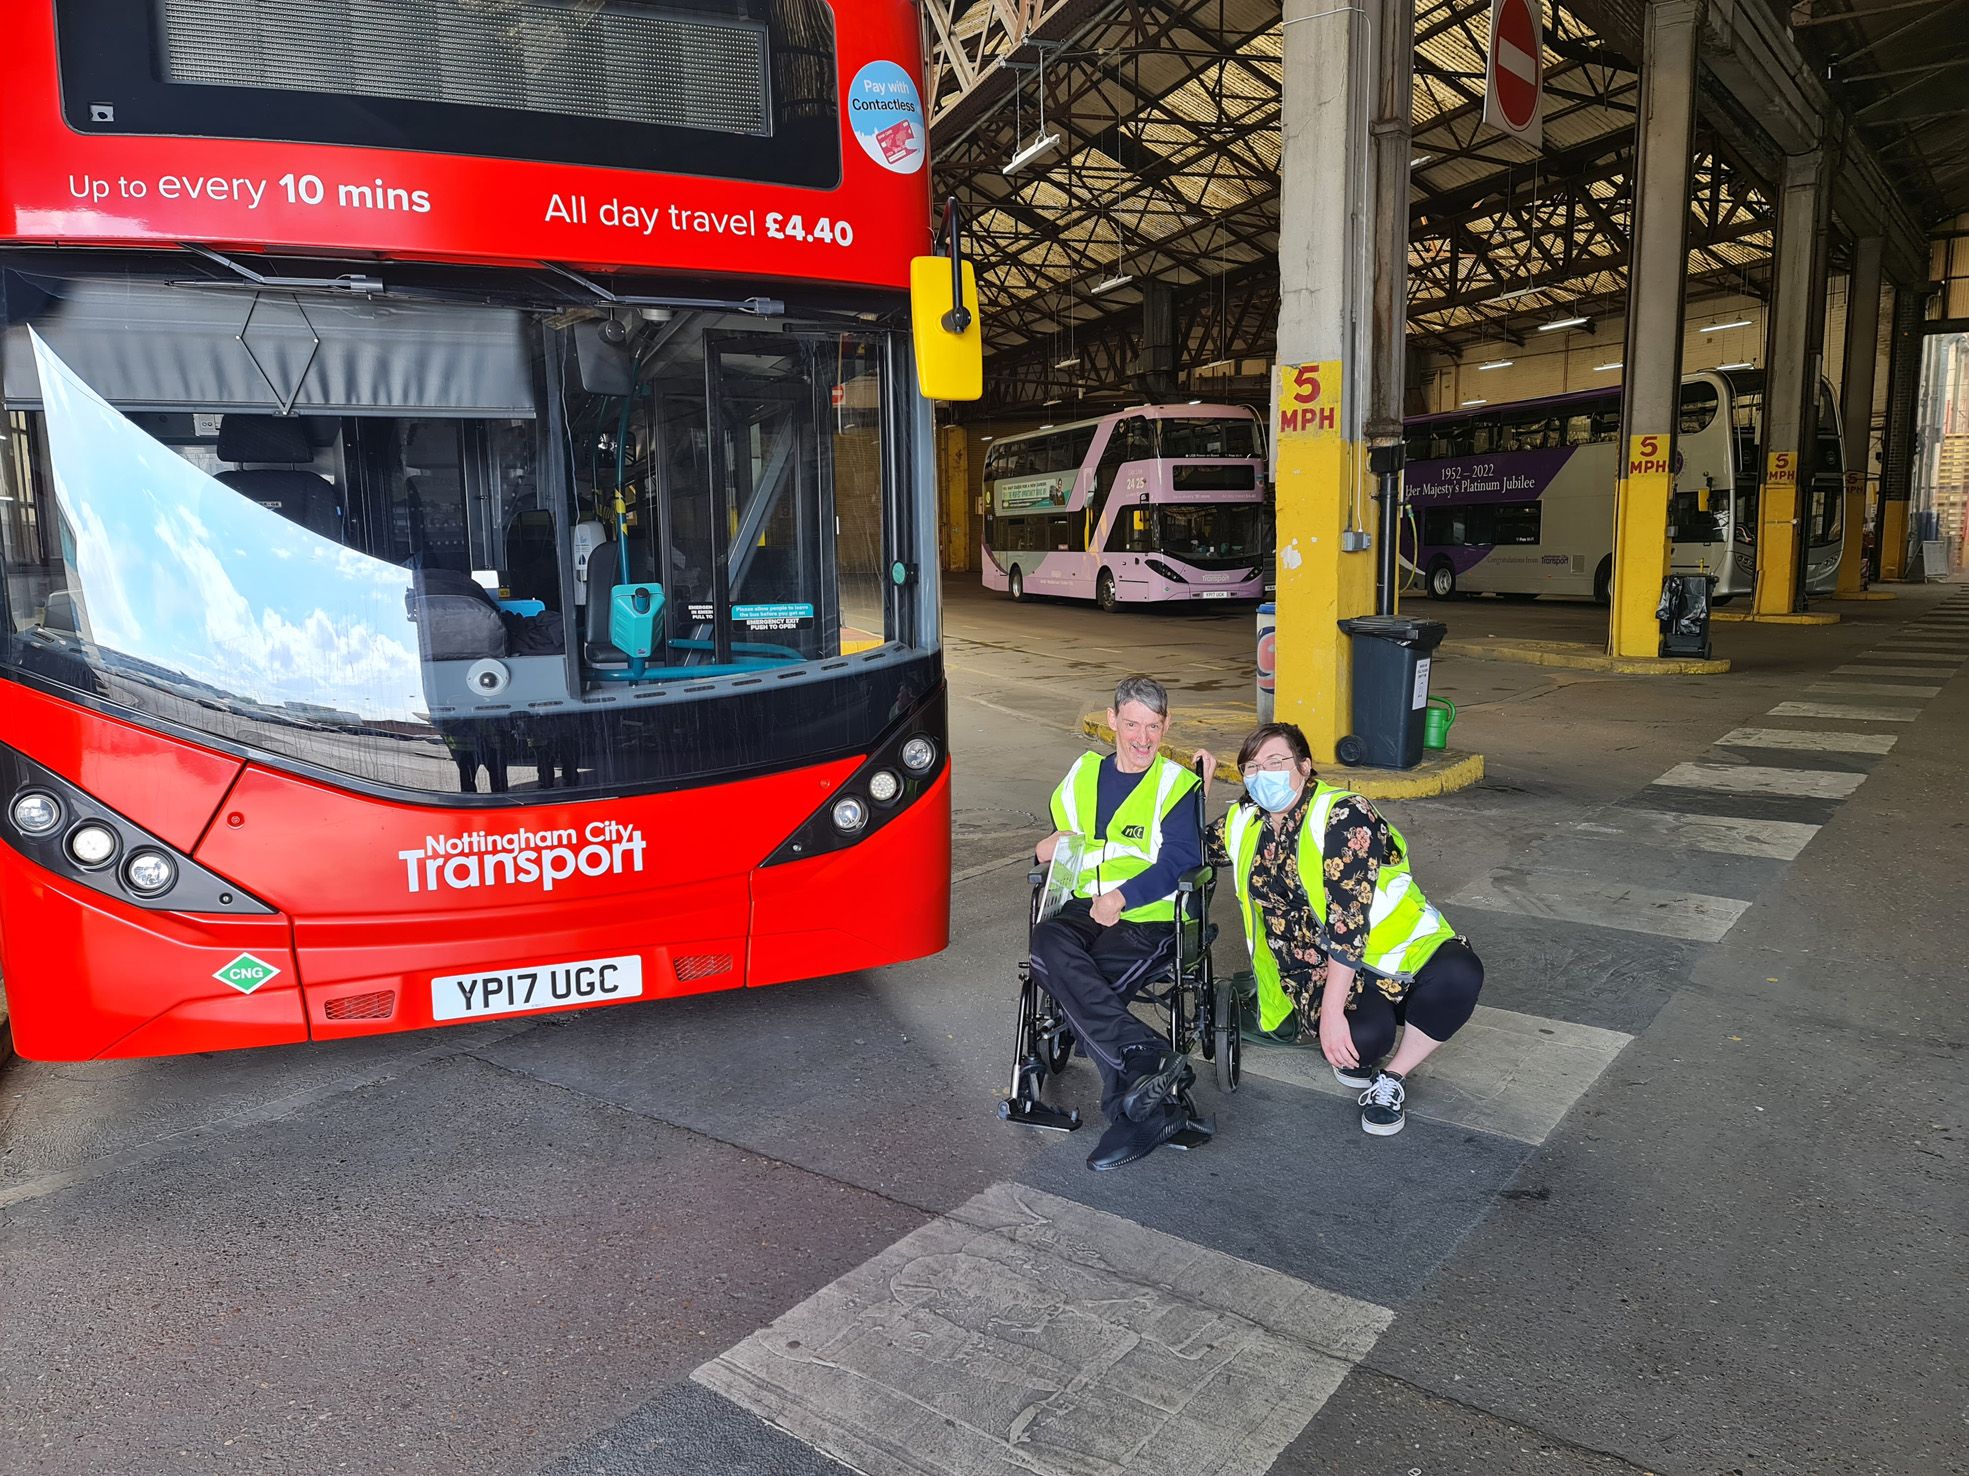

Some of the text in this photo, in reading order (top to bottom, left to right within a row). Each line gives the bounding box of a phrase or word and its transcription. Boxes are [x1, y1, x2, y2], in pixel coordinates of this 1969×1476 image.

[863, 80, 910, 95] Pay with
[852, 98, 916, 112] Contactless
[68, 173, 431, 213] Up to every 10 mins
[544, 193, 854, 247] All day travel £4.40
[1293, 365, 1321, 404] 5
[1280, 407, 1335, 432] MPH
[1640, 435, 1658, 457] 5
[1441, 466, 1461, 480] 1952
[1472, 464, 1494, 478] 2022
[1630, 460, 1667, 474] MPH
[1775, 453, 1789, 469] 5
[1405, 475, 1535, 498] Her Majesty's Platinum Jubilee
[1768, 470, 1795, 481] MPH
[425, 820, 634, 857] Nottingham City
[398, 830, 647, 893] Transport
[229, 967, 264, 980] CNG
[457, 964, 619, 1010] YP17 UGC
